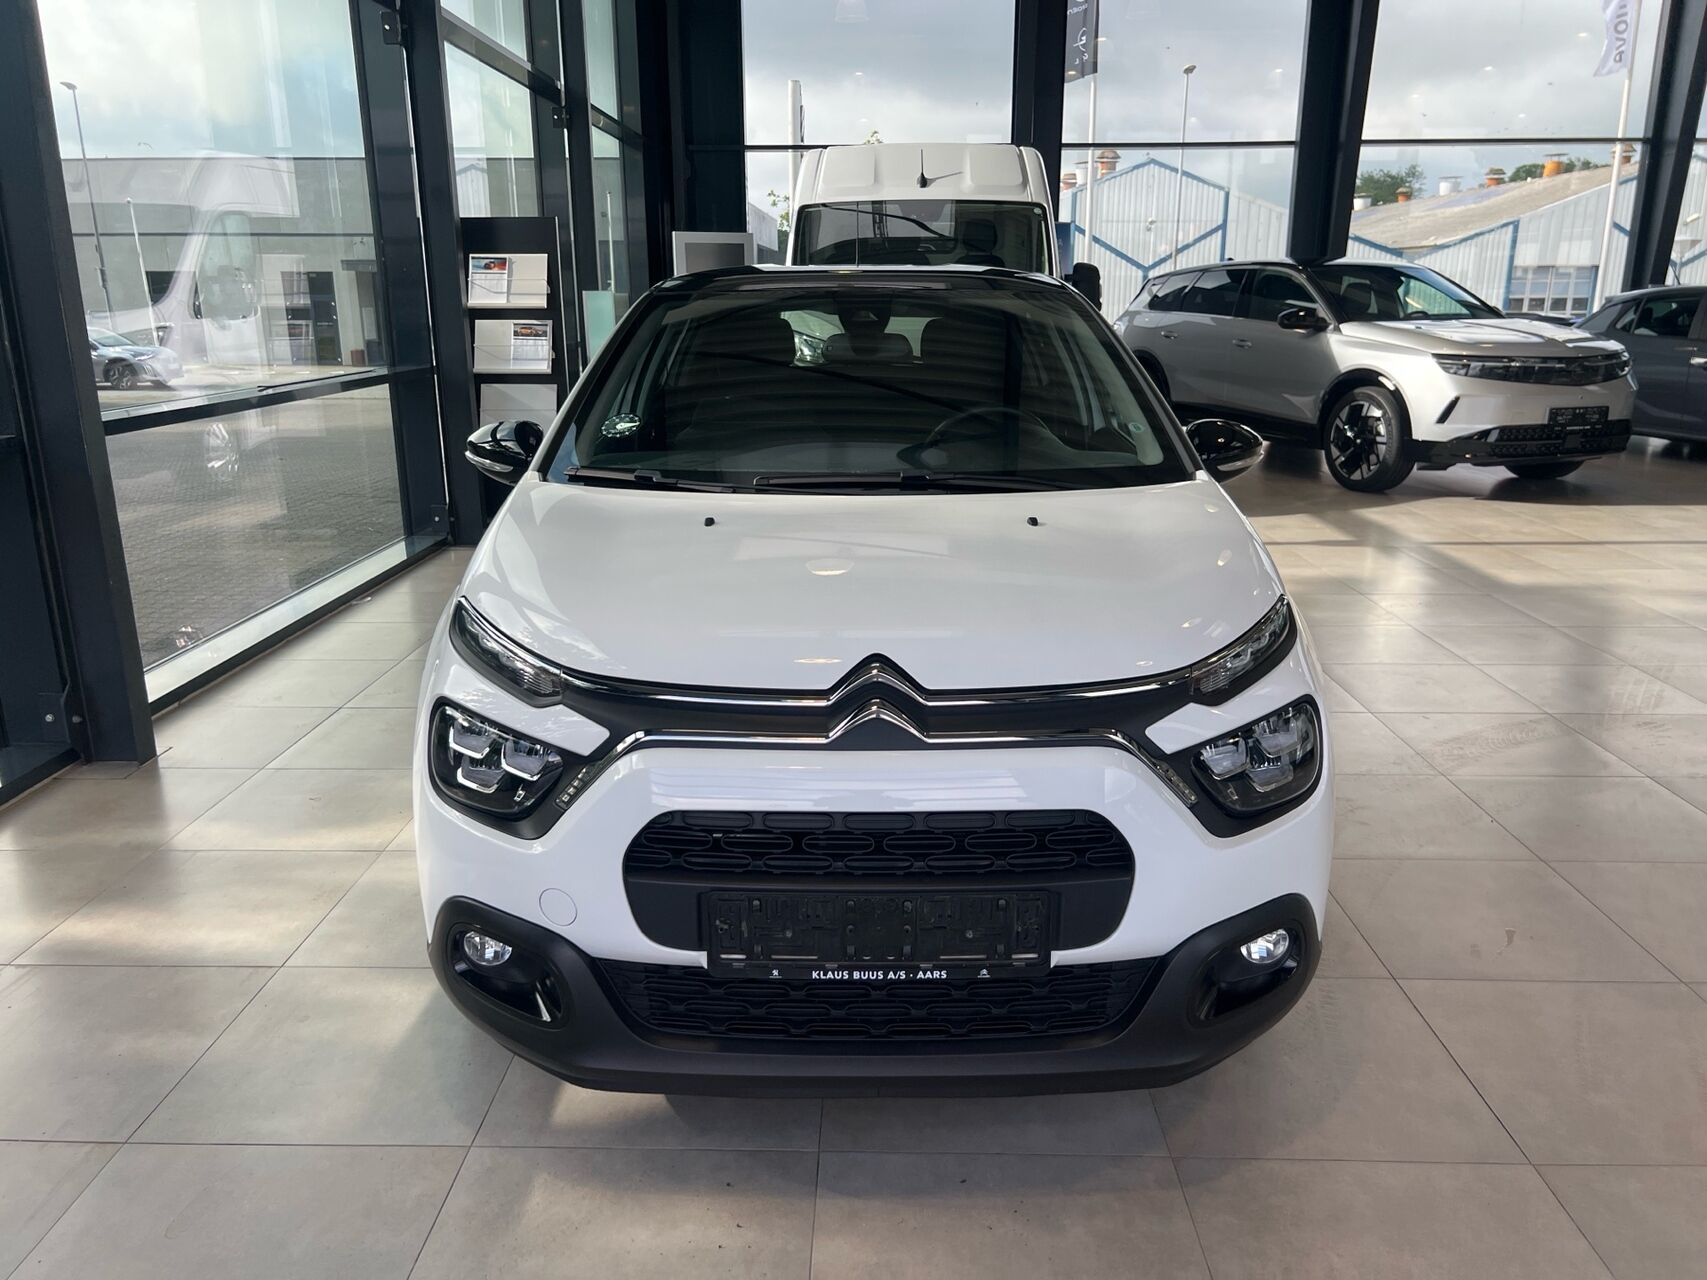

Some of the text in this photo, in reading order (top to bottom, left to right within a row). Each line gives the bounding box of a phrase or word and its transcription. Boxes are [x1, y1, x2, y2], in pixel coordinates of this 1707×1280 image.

[812, 970, 849, 979] KLAUS
[853, 970, 884, 979] BUUS
[887, 970, 906, 979] A/S
[916, 970, 947, 979] AARS
